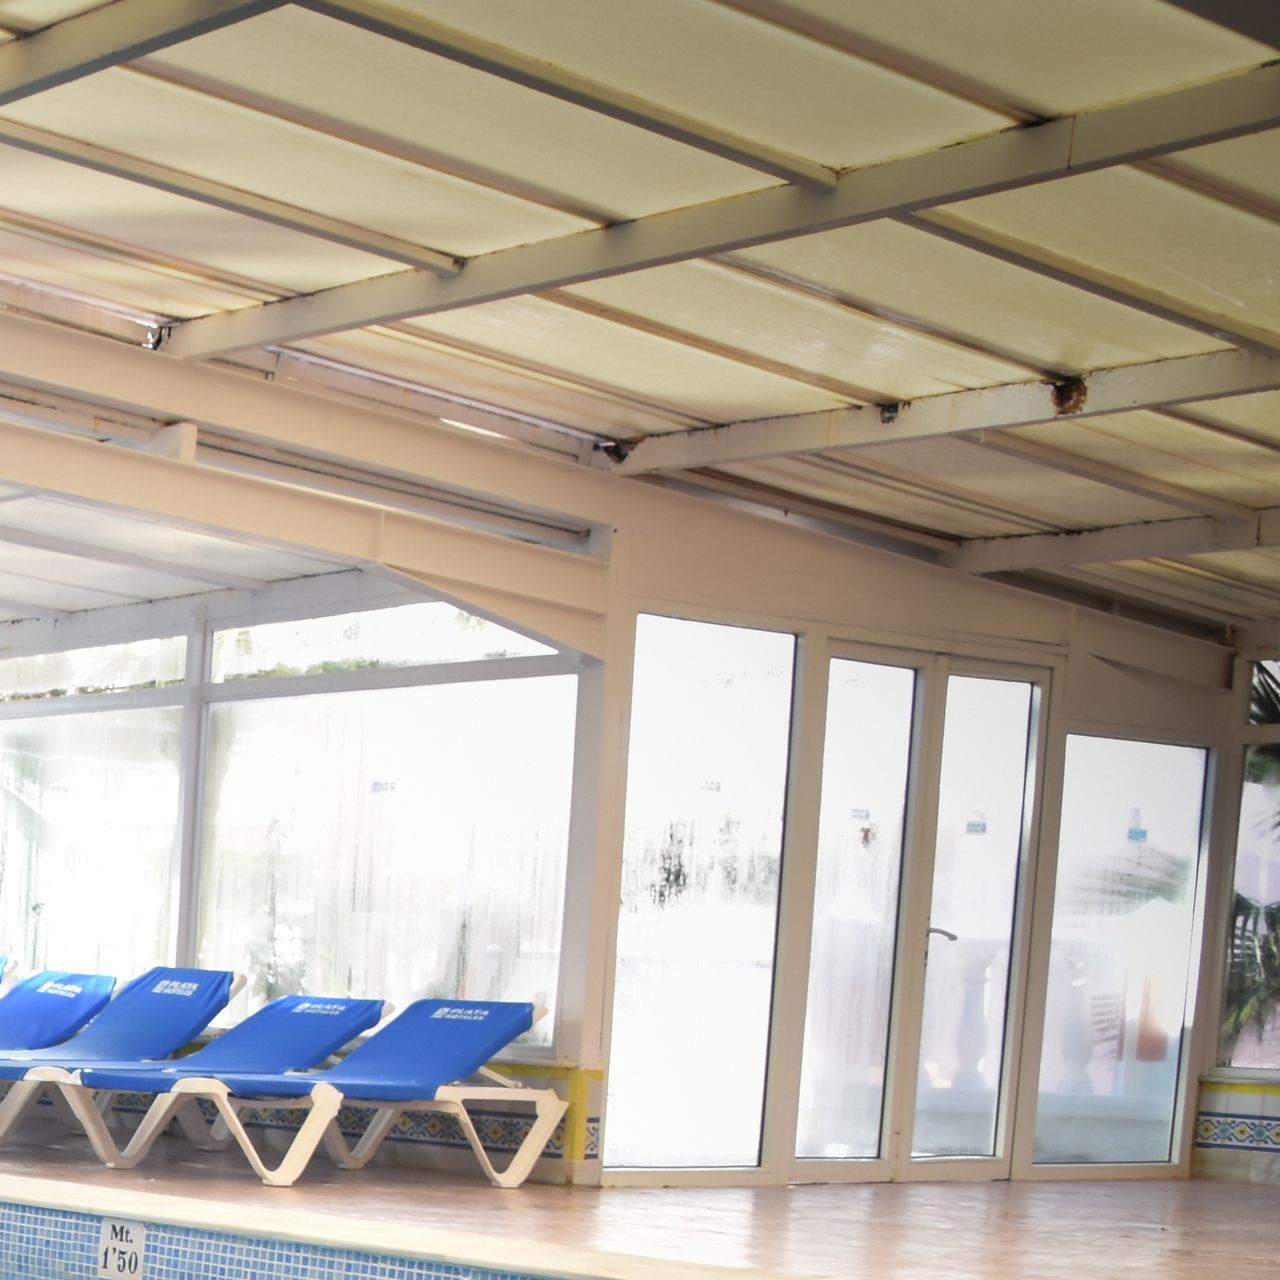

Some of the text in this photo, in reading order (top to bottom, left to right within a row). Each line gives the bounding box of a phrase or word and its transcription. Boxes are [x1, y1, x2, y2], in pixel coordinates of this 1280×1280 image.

[446, 1007, 489, 1016] PLATA
[110, 1223, 133, 1243] Mt.
[102, 1246, 138, 1274] 1'50
